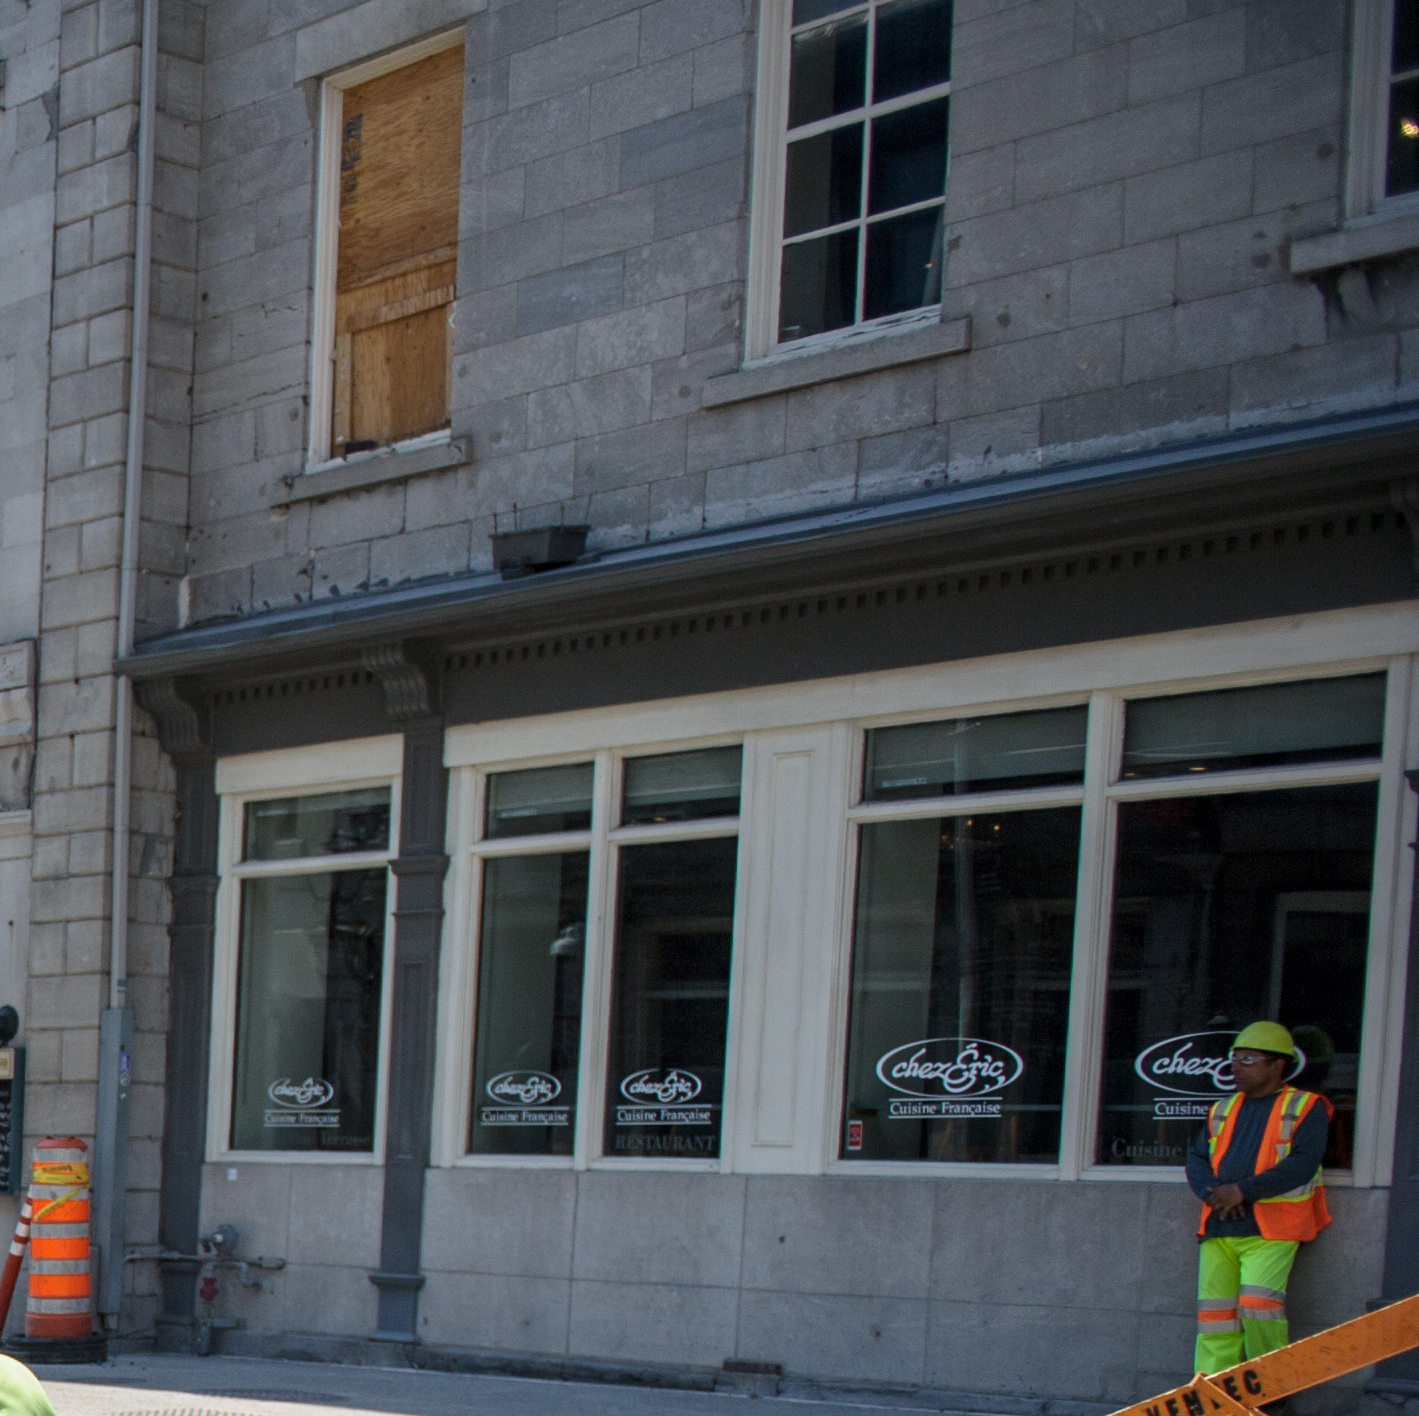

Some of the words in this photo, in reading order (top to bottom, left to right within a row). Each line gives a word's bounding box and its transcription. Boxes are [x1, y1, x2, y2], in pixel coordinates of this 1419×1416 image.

[892, 1048, 952, 1080] chez
[1153, 1042, 1218, 1076] chez
[617, 1109, 658, 1121] Cuisine
[661, 1108, 712, 1124] Française
[890, 1102, 937, 1116] Cuisine
[941, 1101, 1001, 1117] Française
[1154, 1102, 1208, 1116] Cuisine
[266, 1113, 297, 1123] Cuisine
[299, 1112, 339, 1125] Française
[483, 1111, 519, 1122] Cuisine
[523, 1110, 568, 1125] Française
[616, 1134, 716, 1151] RESTAURANT
[1111, 1136, 1183, 1158] Cuisine
